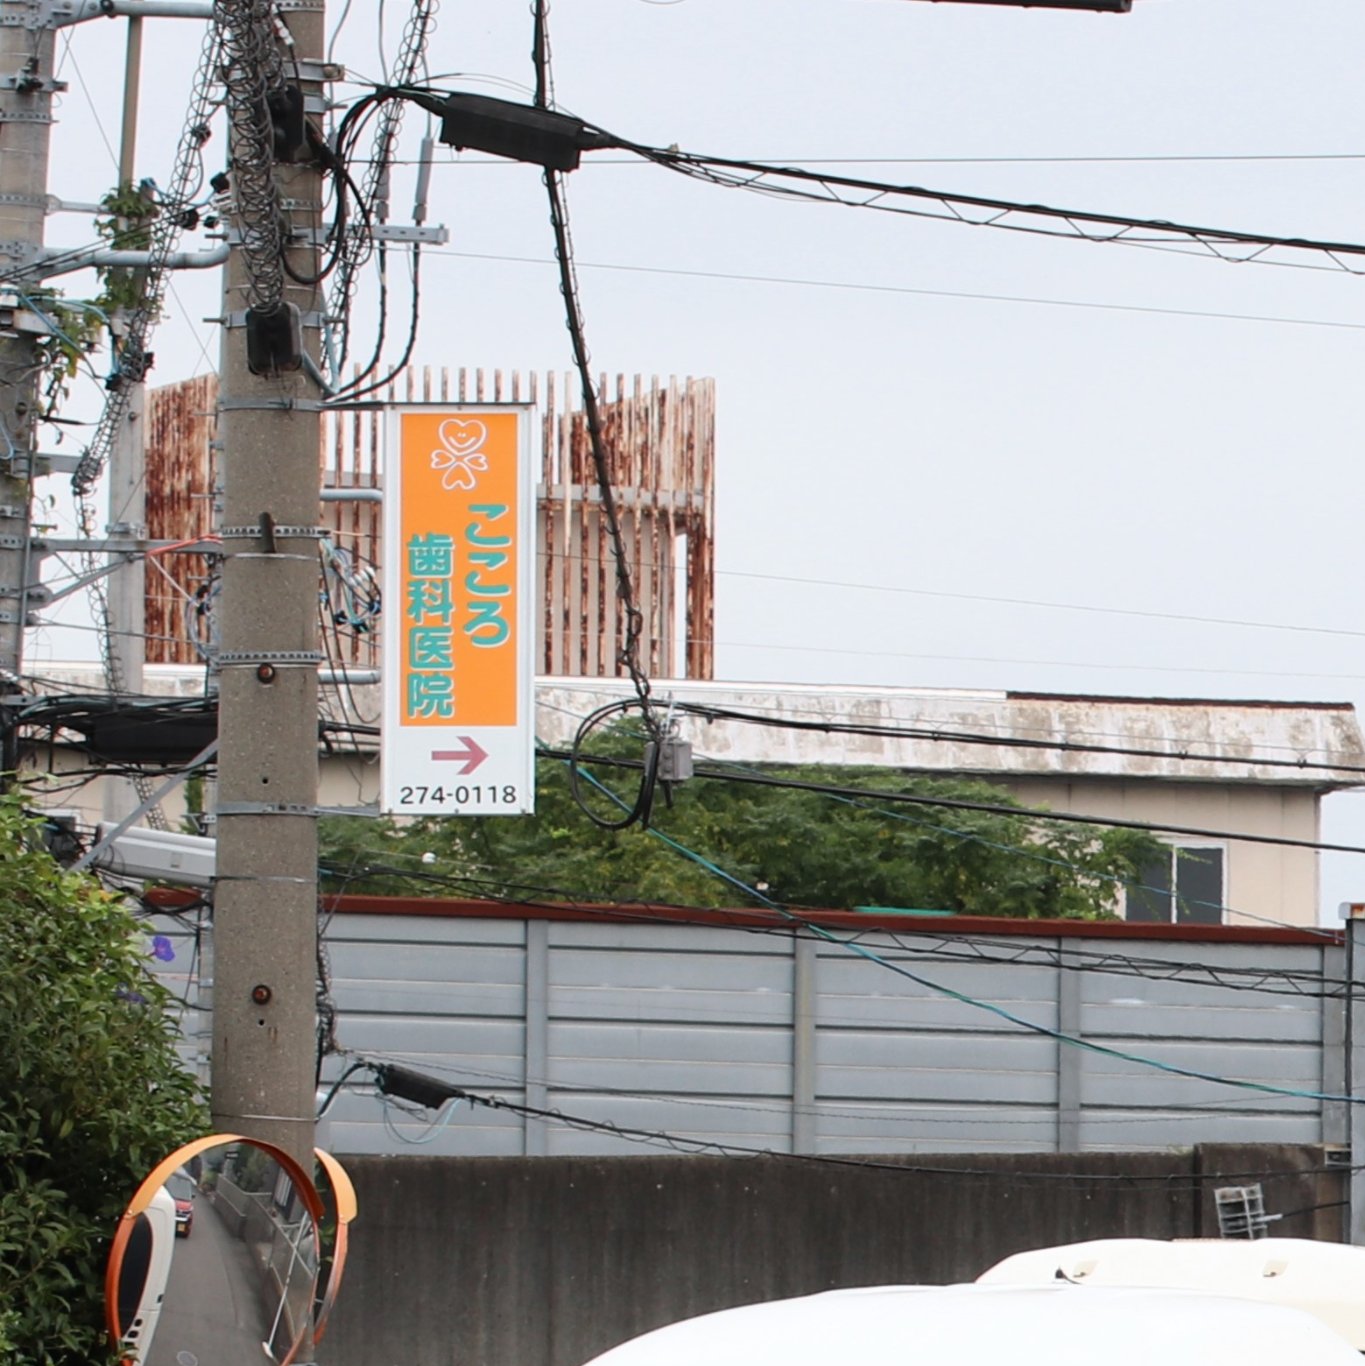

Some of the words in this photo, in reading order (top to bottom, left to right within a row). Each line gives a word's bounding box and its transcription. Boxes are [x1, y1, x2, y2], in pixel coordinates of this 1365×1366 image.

[406, 532, 455, 718] 歯科医院
[463, 502, 512, 649] こころ
[400, 785, 517, 805] 274-0118
